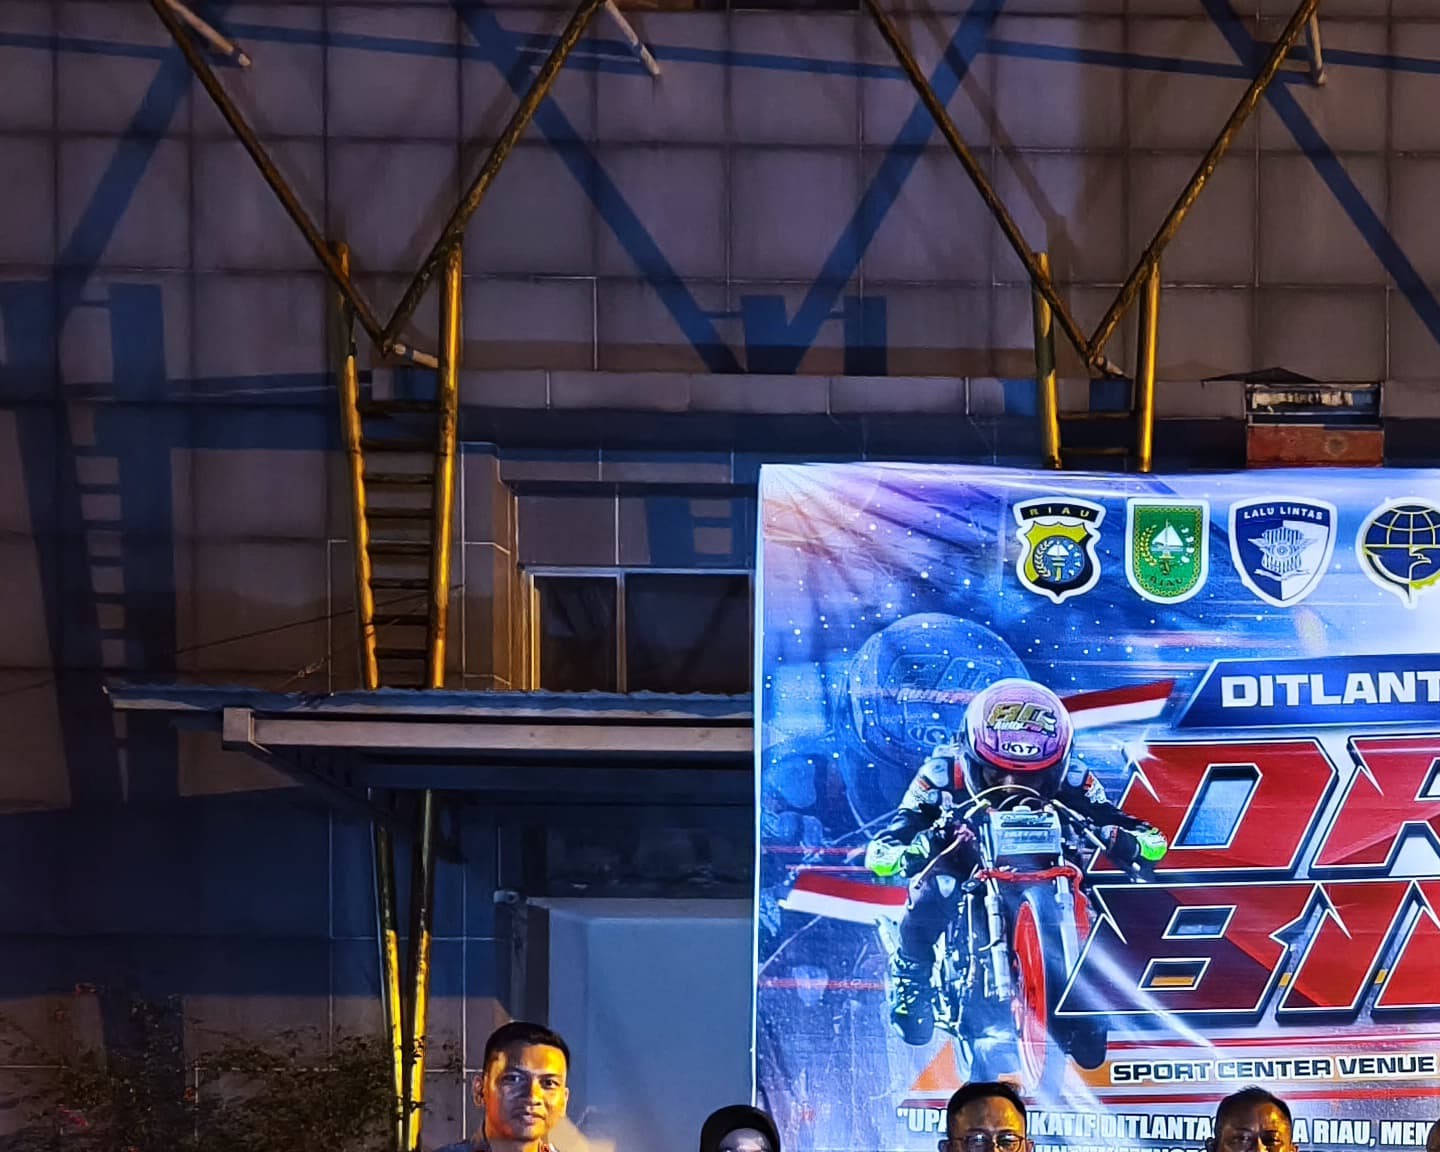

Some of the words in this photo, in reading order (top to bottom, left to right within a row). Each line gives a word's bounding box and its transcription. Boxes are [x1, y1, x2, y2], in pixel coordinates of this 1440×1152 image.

[1029, 506, 1090, 518] RIAU
[1244, 507, 1275, 519] LALU
[1280, 505, 1323, 520] LINTAS
[1113, 1062, 1211, 1081] SPORT
[1217, 1058, 1331, 1079] CENTER
[1336, 1053, 1435, 1075] VENUE
[1319, 1119, 1375, 1147] RIAU,
